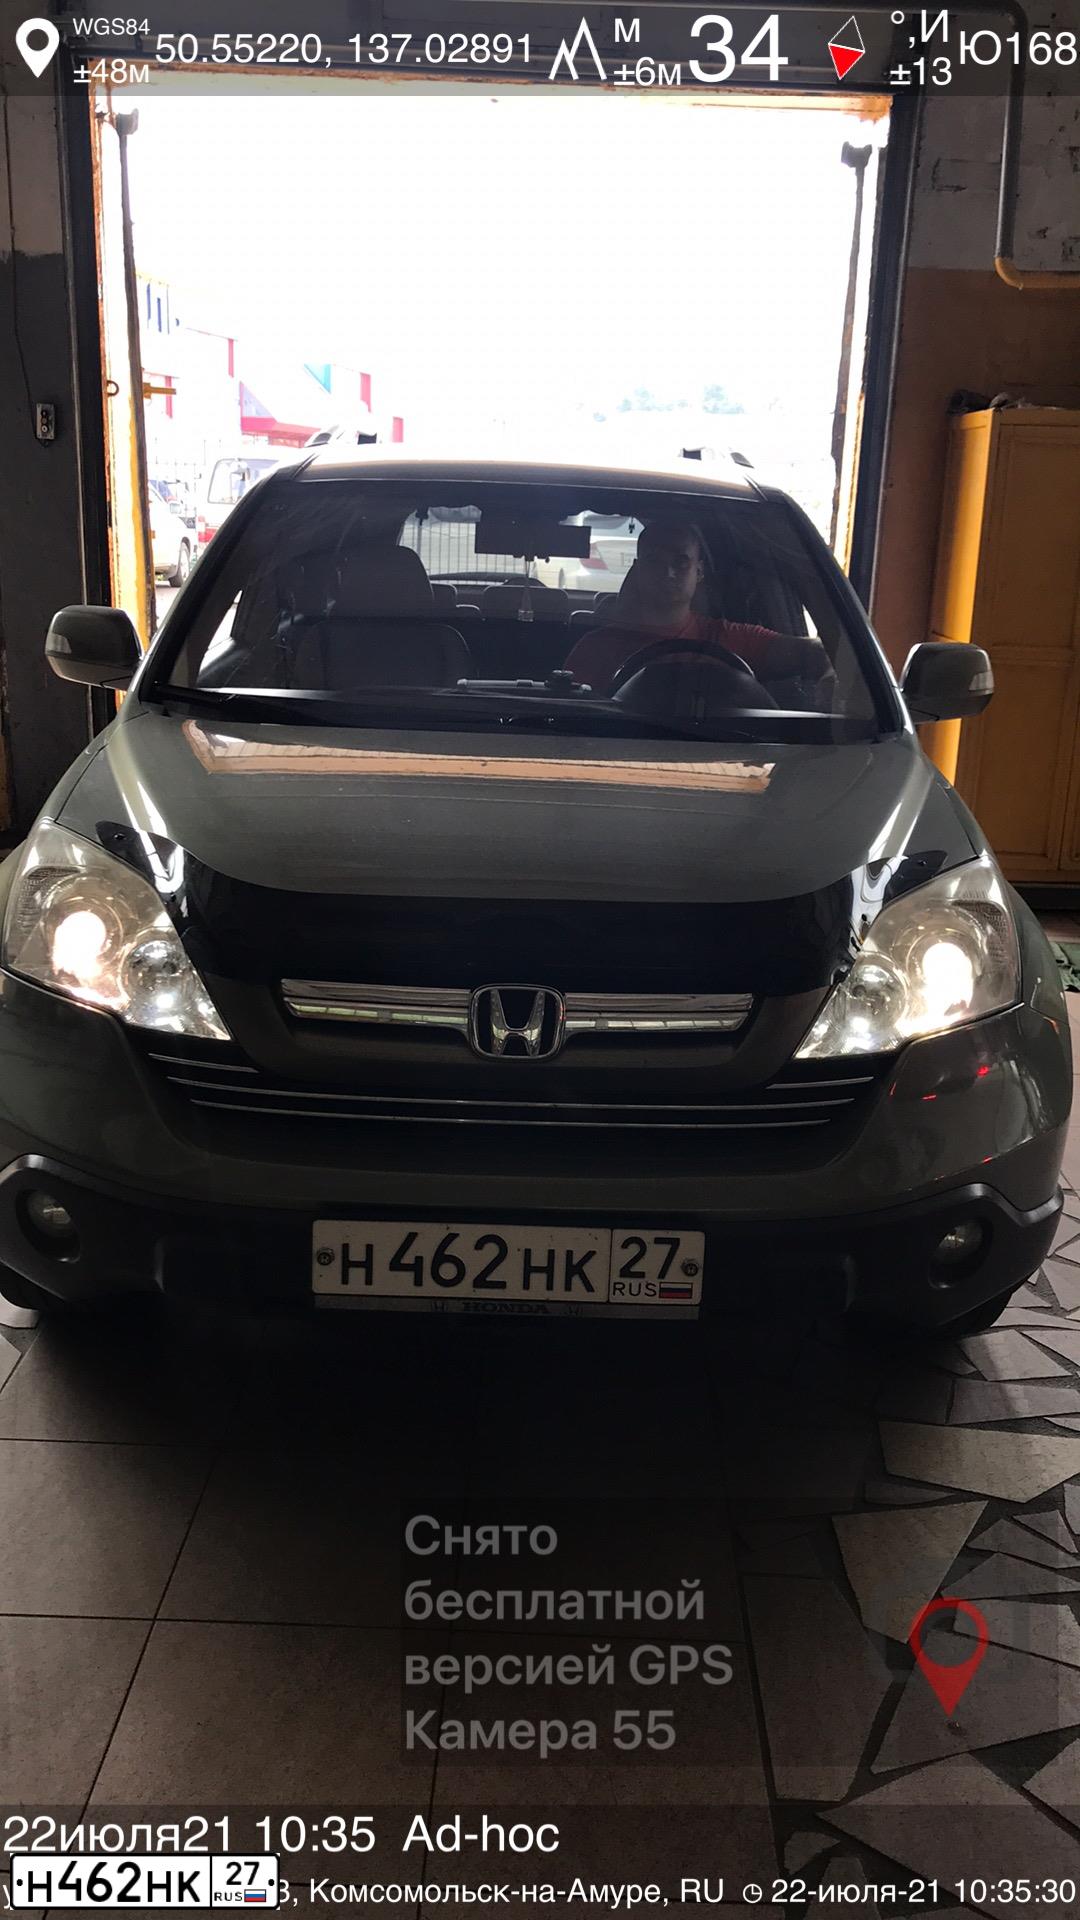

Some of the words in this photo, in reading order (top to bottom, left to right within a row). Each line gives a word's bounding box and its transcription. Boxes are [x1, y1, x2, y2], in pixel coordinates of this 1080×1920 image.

[619, 1236, 681, 1280] 27
[612, 1282, 657, 1297] RUS
[462, 1301, 549, 1314] HONDA
